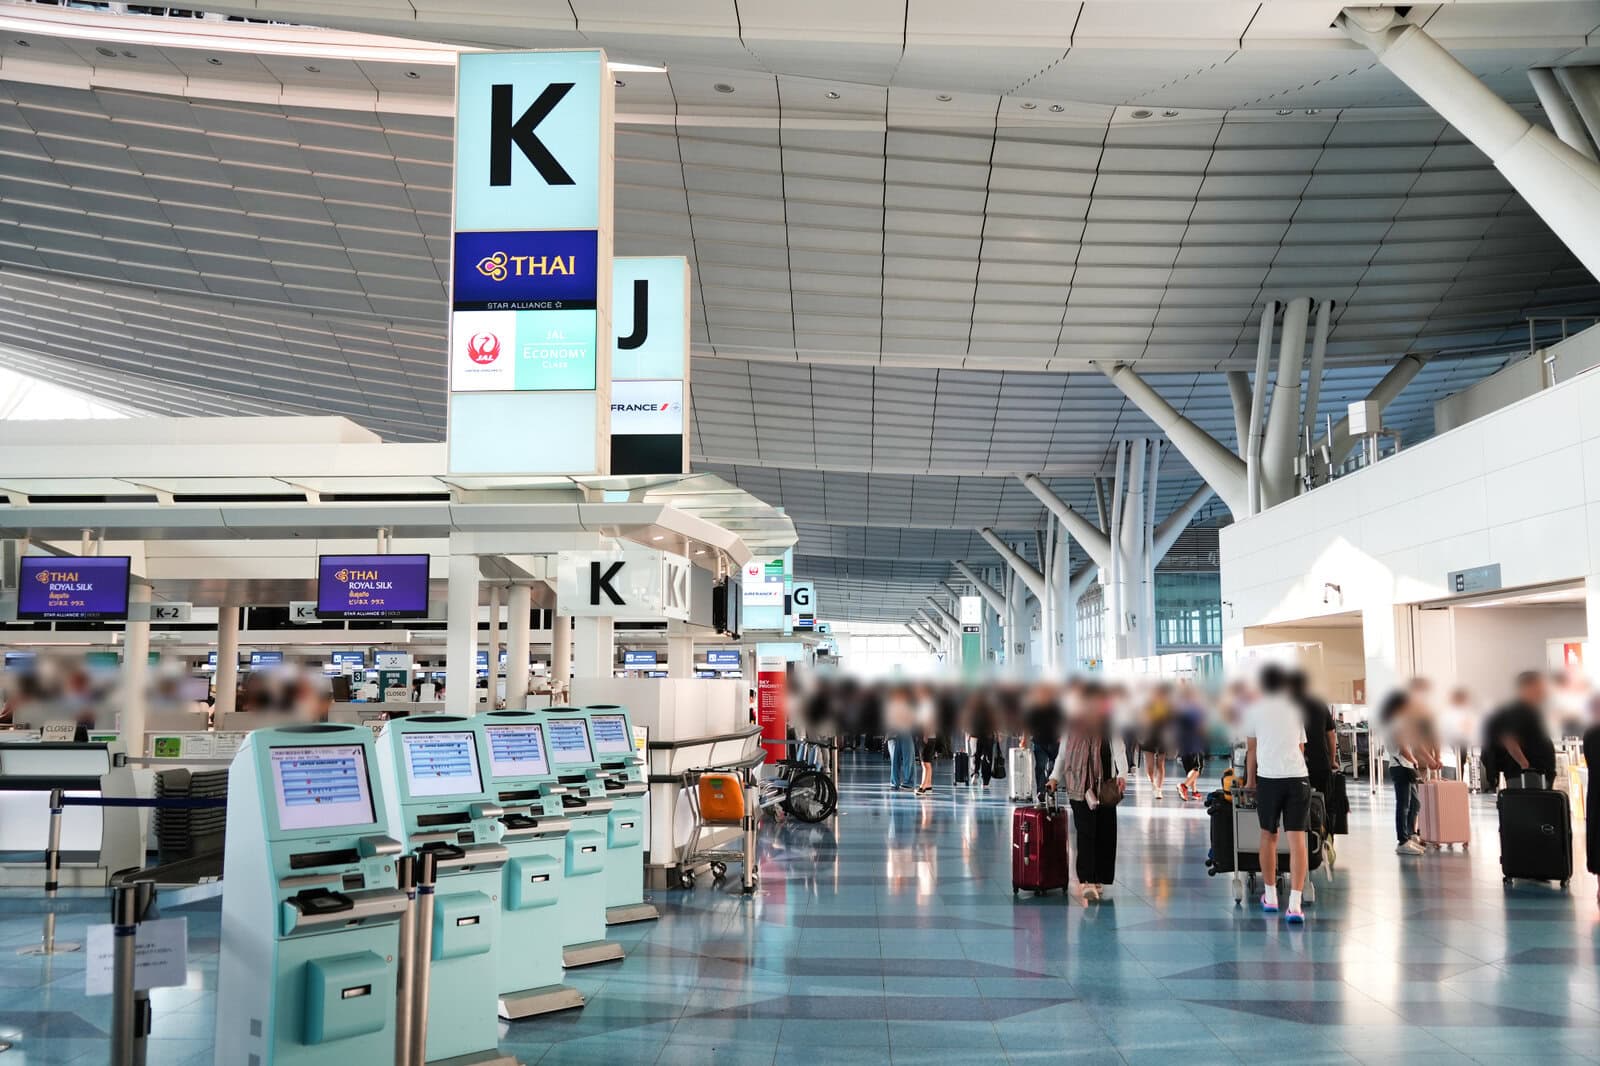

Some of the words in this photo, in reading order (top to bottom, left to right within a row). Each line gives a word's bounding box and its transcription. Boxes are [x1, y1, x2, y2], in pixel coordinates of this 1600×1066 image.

[490, 83, 576, 186] K
[510, 255, 575, 276] THAI
[487, 302, 509, 310] STAR
[510, 301, 552, 310] ALLIANCE
[617, 279, 649, 350] J
[610, 403, 658, 412] FRANCE
[50, 572, 79, 582] THAI
[349, 570, 378, 580] THAI
[49, 583, 75, 591] ROYAL
[76, 583, 93, 591] SILK
[348, 581, 375, 590] ROYAL
[376, 581, 393, 589] SILK
[590, 561, 626, 605] K
[793, 587, 809, 606] G
[156, 607, 179, 618] K-2
[45, 725, 74, 734] CLOSED
